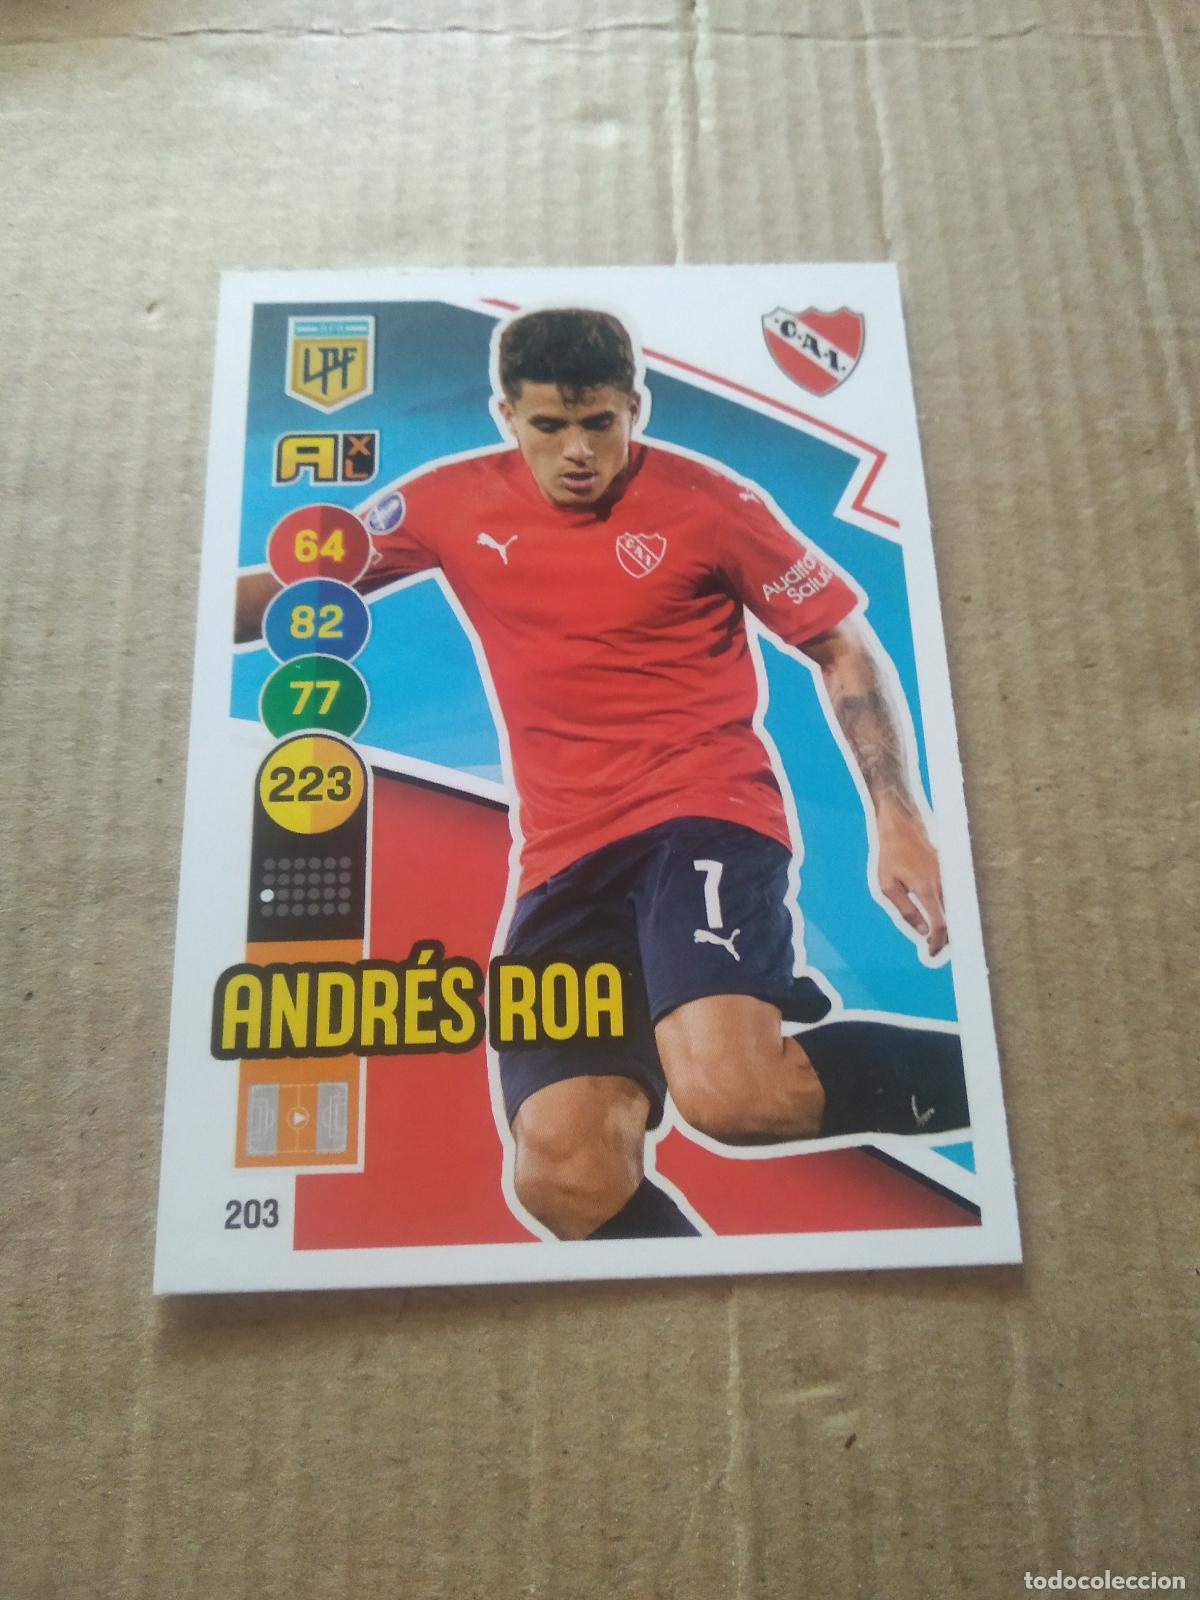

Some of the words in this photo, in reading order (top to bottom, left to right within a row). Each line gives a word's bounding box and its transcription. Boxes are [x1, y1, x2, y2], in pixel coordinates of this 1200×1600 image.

[294, 529, 346, 563] 64
[290, 604, 344, 639] 82
[289, 680, 341, 716] 77
[268, 766, 352, 803] 223
[693, 859, 723, 928] 7
[221, 949, 476, 1049] ANDRÉS
[500, 962, 624, 1041] ROA
[224, 1199, 279, 1230] 203
